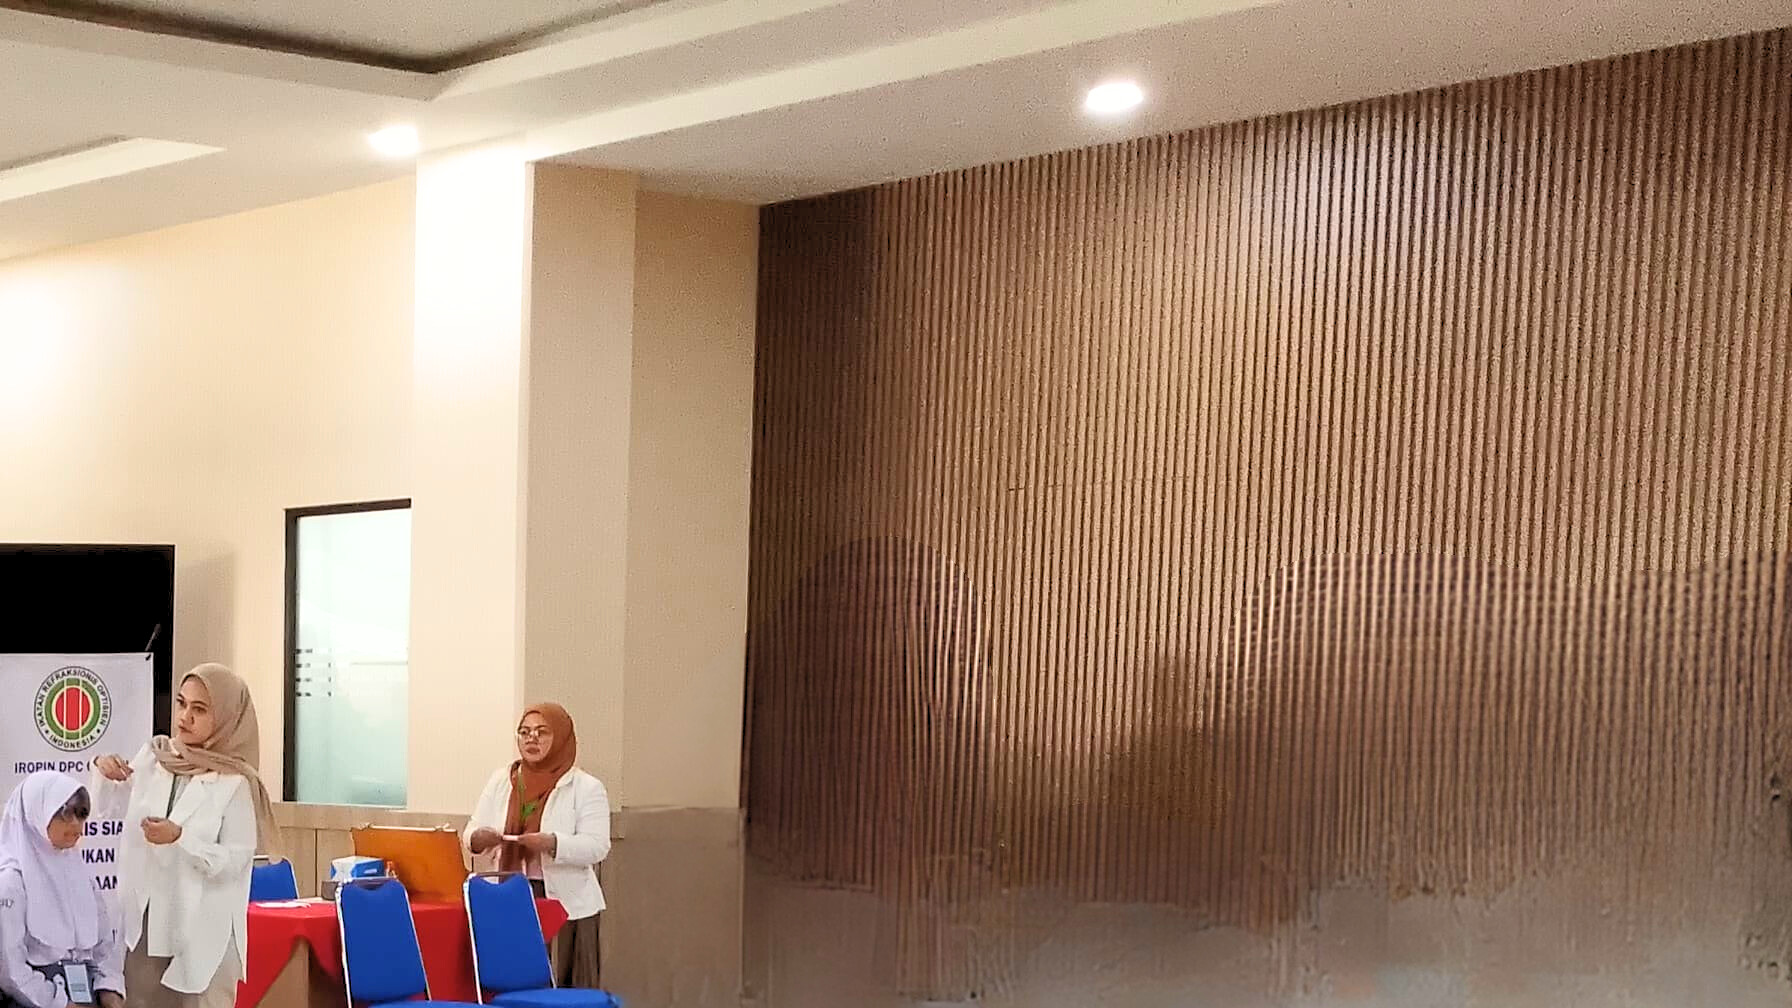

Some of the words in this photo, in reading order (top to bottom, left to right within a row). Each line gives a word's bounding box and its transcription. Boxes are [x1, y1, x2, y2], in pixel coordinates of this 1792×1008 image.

[36, 694, 46, 727] IKATAN
[42, 669, 98, 692] REFRAKSIONIS
[96, 685, 110, 726] OPTISIEN
[49, 734, 96, 749] INDONESIA
[14, 761, 55, 774] IROPIN
[59, 761, 84, 773] DPC
